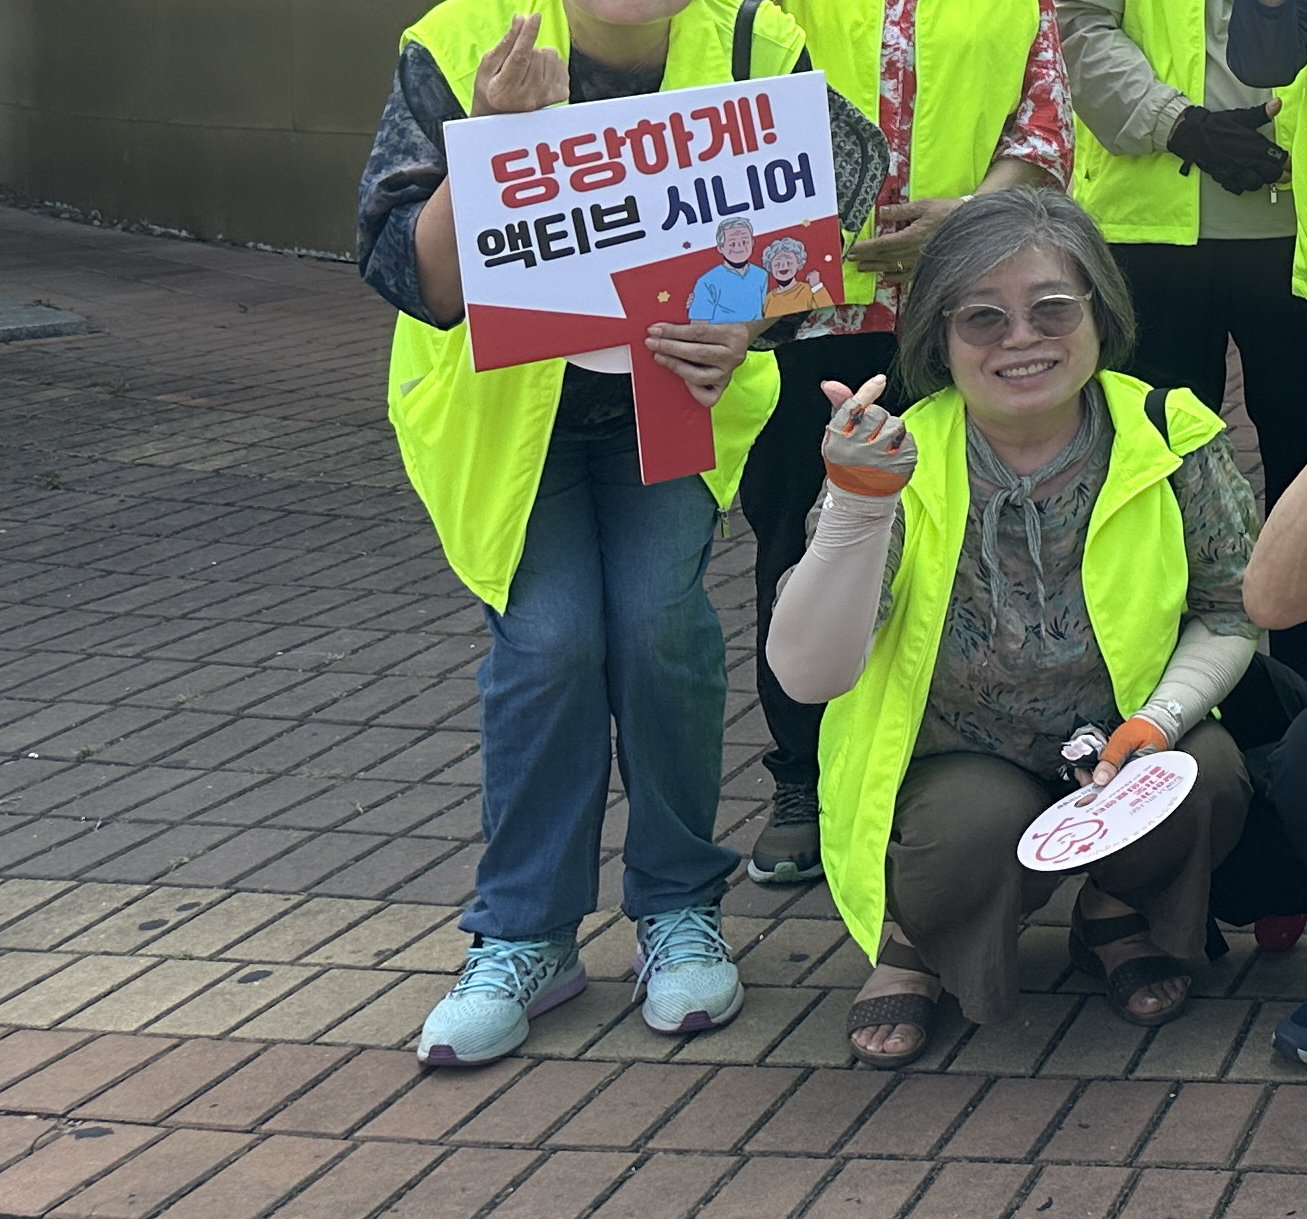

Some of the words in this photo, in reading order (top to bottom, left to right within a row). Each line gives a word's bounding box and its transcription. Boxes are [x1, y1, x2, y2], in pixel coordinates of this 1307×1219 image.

[490, 92, 778, 210] 당당하게!
[476, 195, 646, 269] 액티브
[660, 152, 817, 232] 시니어
